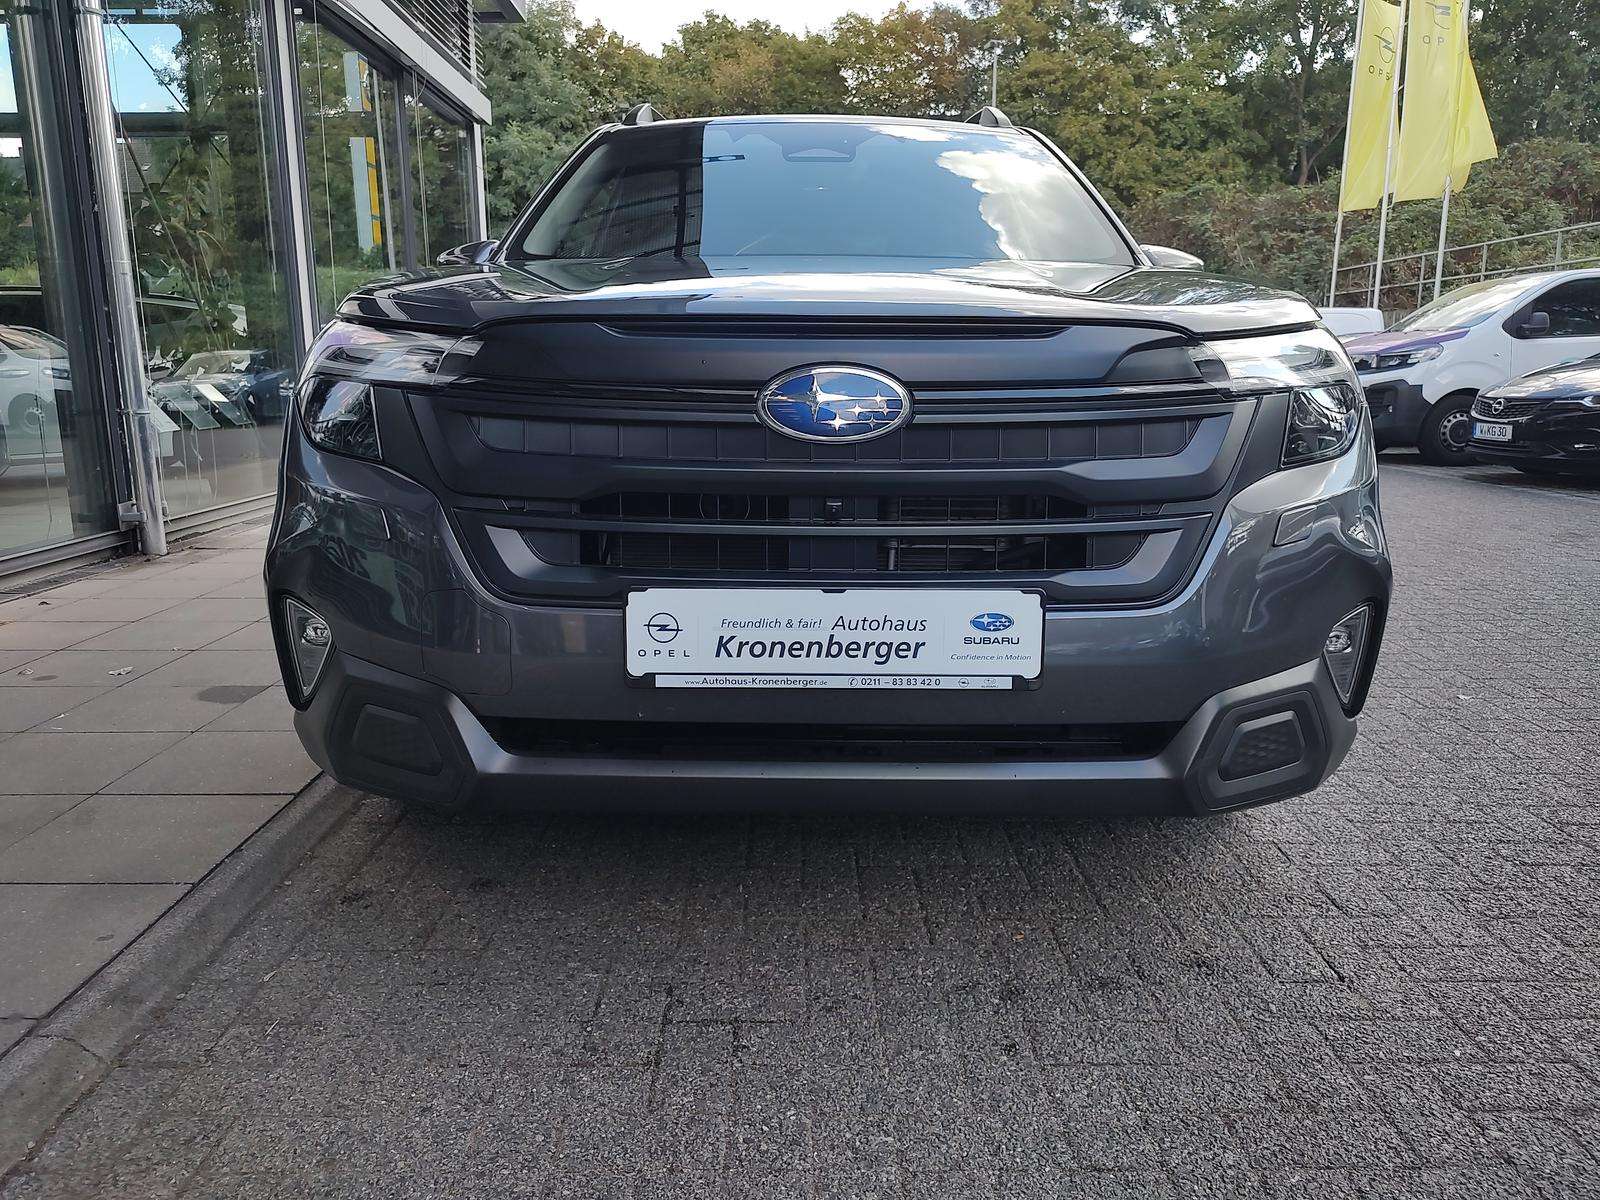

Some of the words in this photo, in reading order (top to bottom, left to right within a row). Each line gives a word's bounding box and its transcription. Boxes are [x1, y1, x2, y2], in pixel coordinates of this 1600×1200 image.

[721, 618, 781, 629] Freundlich
[785, 619, 794, 629] &
[797, 618, 822, 629] fair!
[831, 614, 927, 632] Autohaus
[963, 637, 1020, 645] SUBARU
[637, 649, 690, 658] OPEL
[715, 634, 926, 665] Kronenberger
[950, 653, 995, 661] Confidence
[861, 678, 881, 686] 0211
[892, 678, 903, 686] 83
[906, 678, 918, 686] 83
[920, 678, 932, 686] 42
[934, 678, 941, 686] 0
